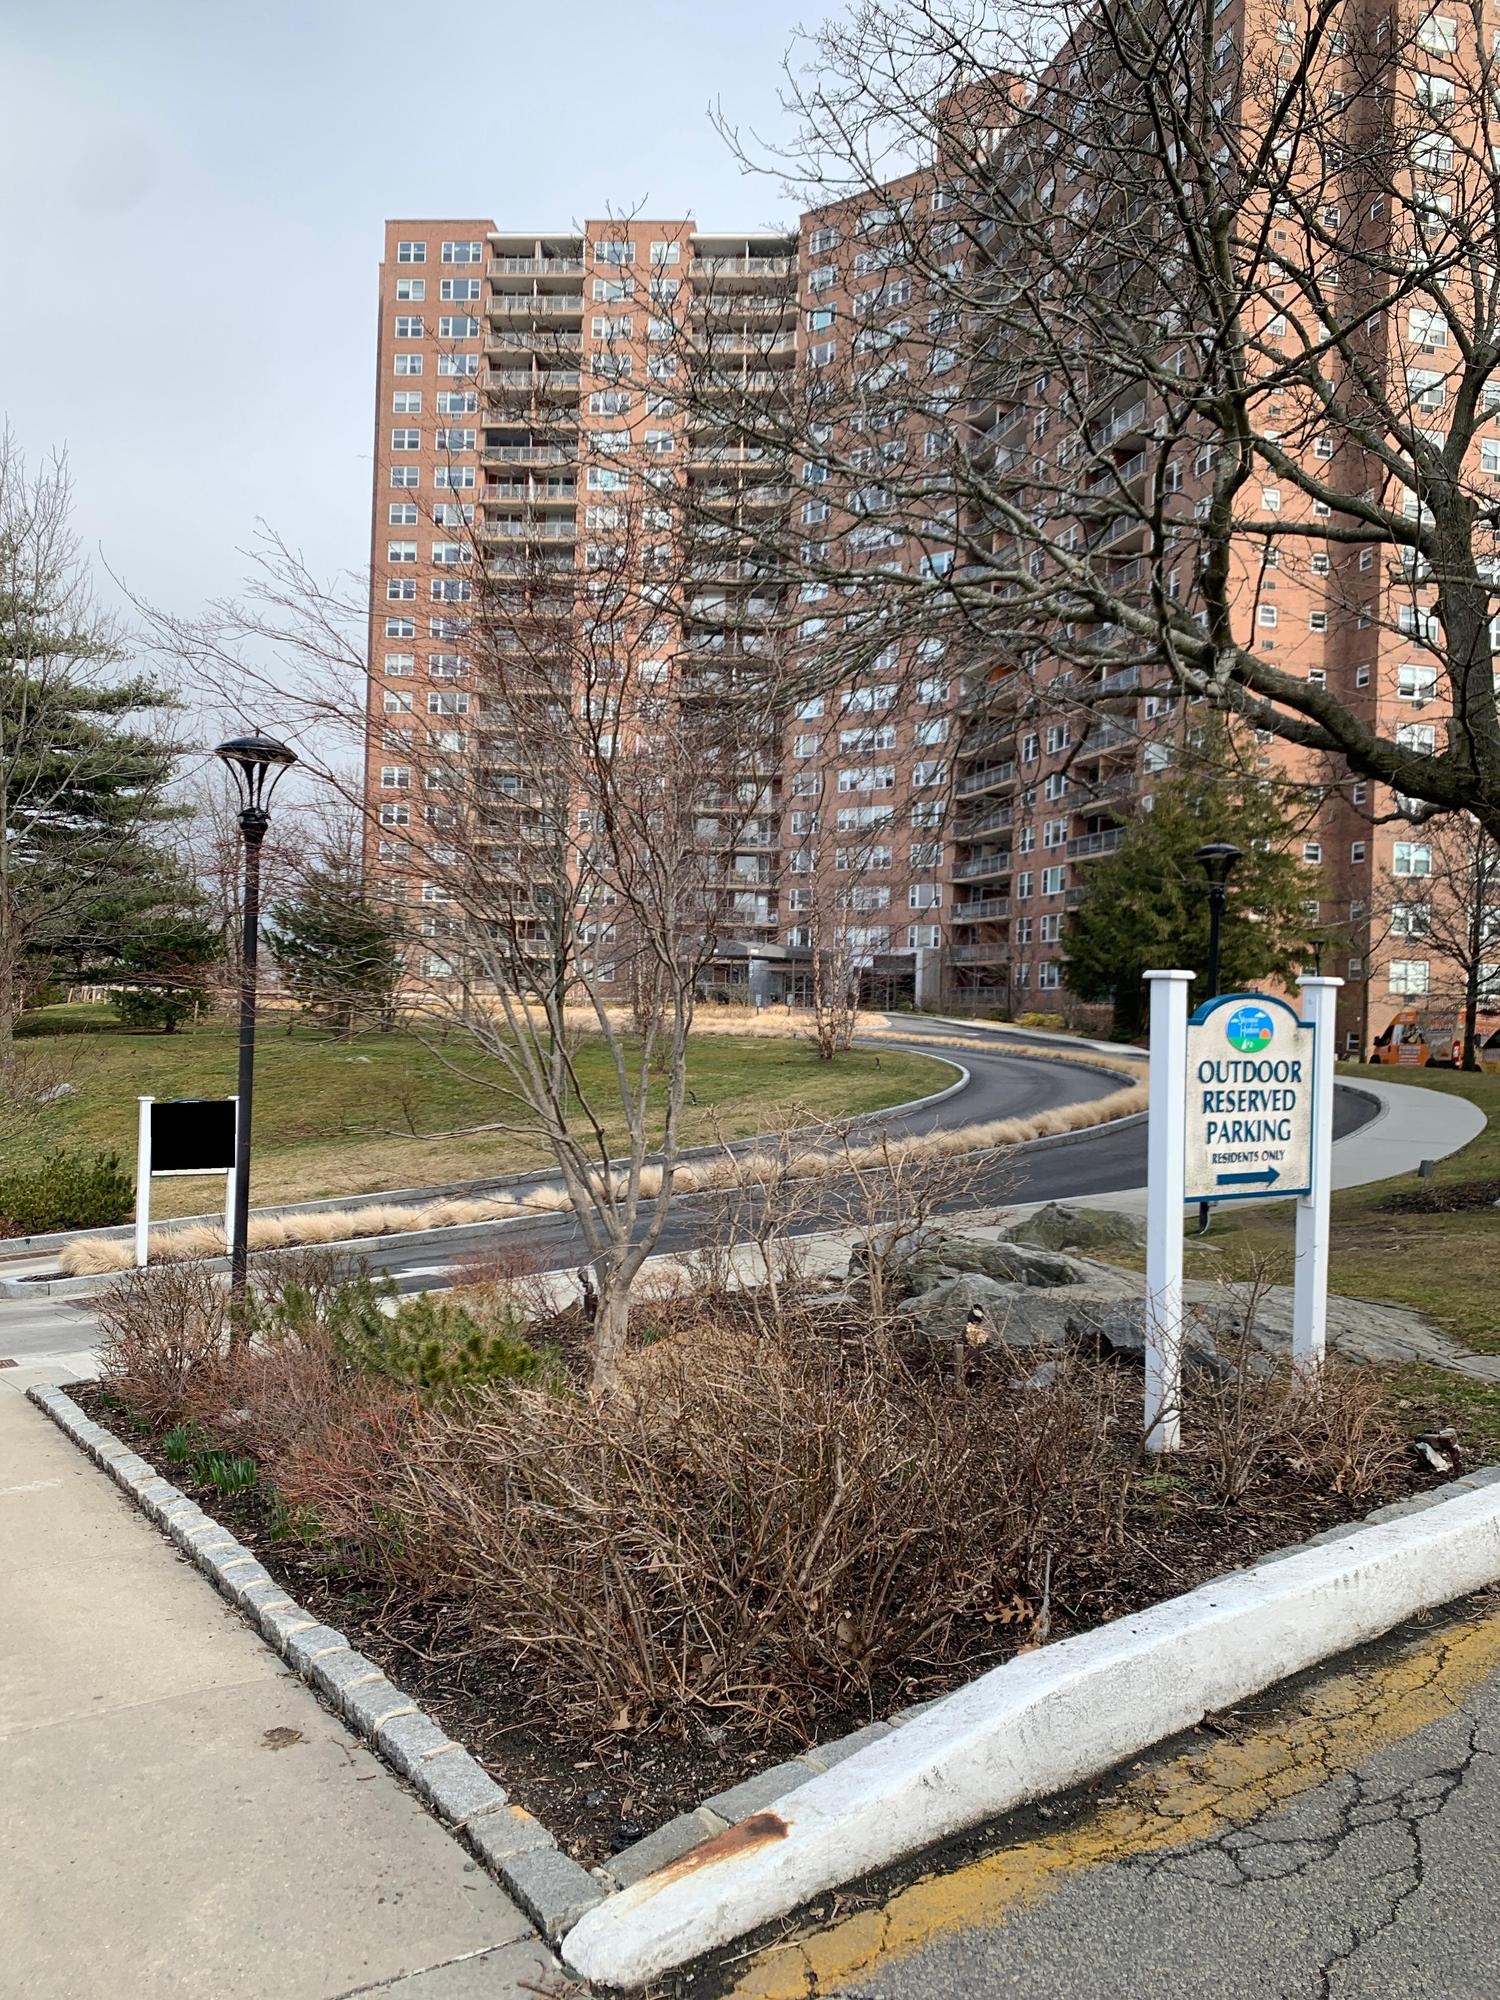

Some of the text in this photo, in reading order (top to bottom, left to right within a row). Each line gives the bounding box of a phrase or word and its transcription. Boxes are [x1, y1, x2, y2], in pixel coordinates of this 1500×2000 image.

[1198, 1060, 1302, 1083] OUTDOOR
[1202, 1089, 1296, 1113] RESERVED
[1206, 1118, 1291, 1144] PARKING
[1212, 1150, 1285, 1164] RESIDENTS ONLY
